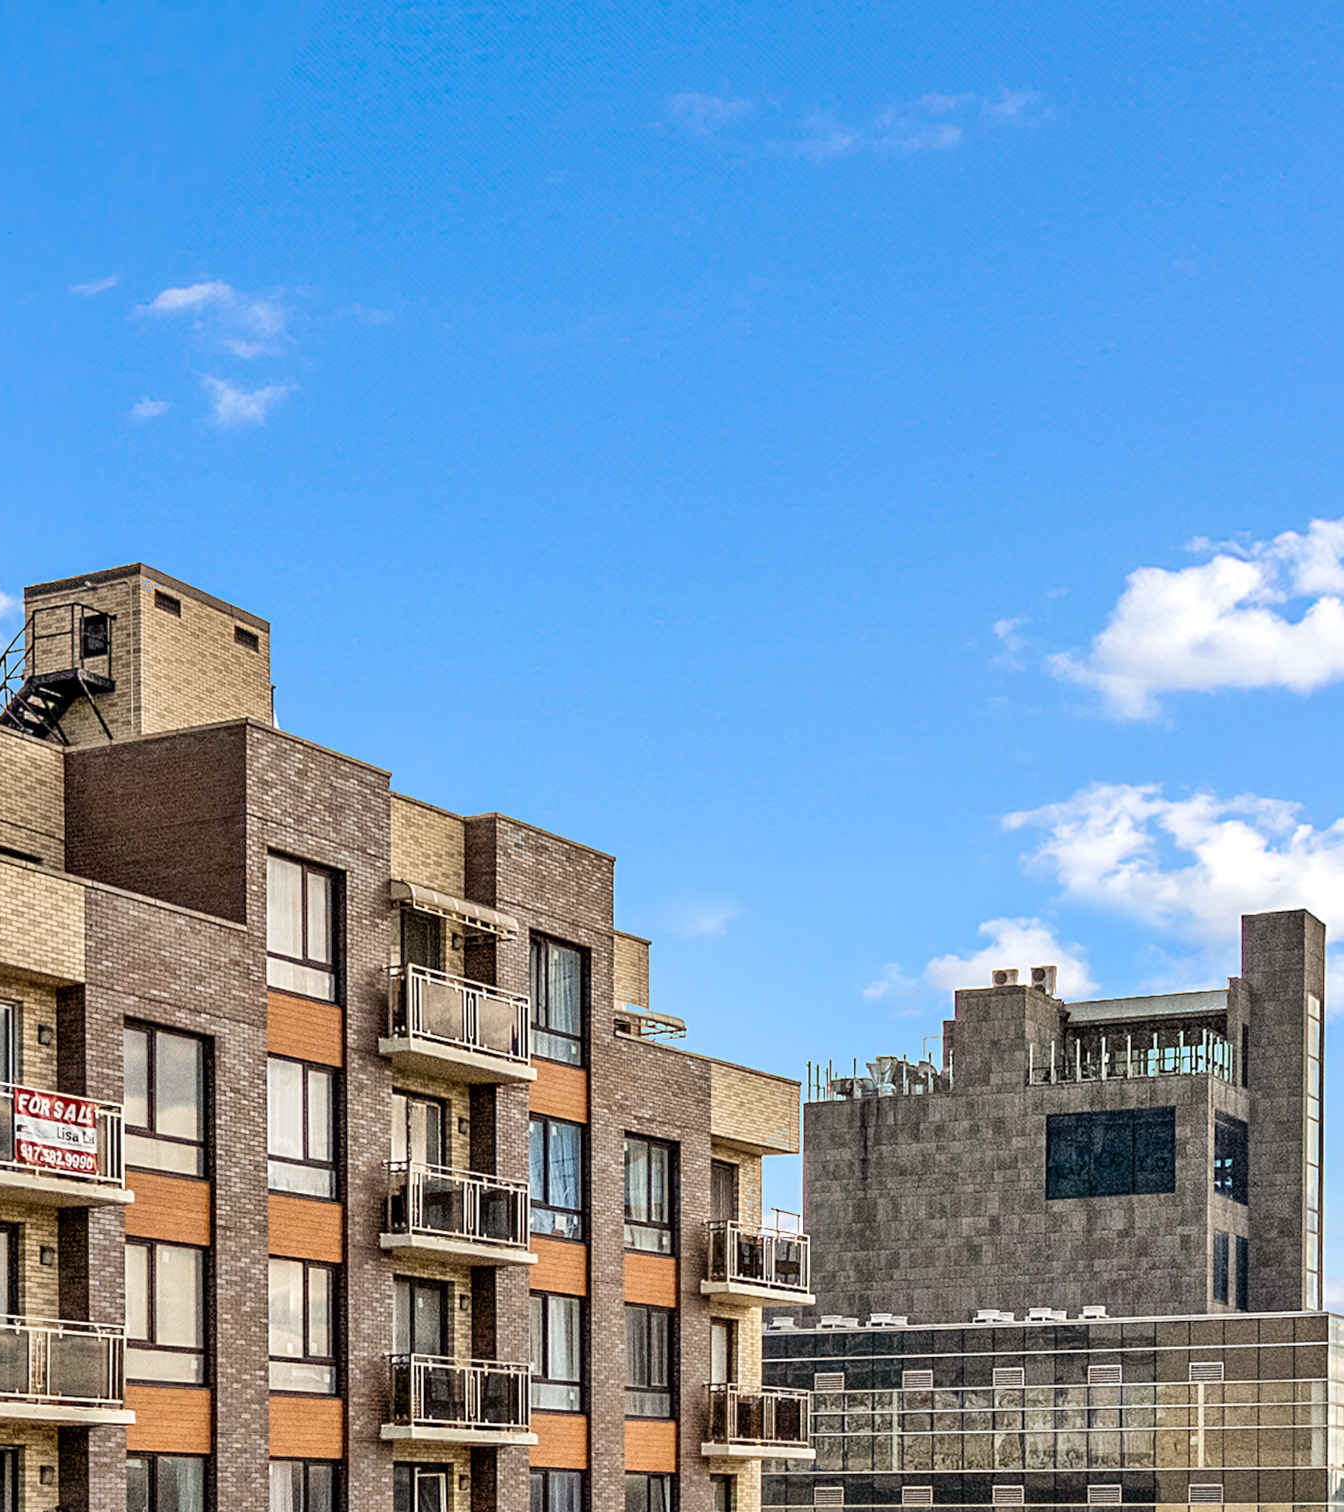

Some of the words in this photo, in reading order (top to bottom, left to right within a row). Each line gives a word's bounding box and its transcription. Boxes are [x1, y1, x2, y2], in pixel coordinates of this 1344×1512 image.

[18, 1093, 51, 1118] FOR
[53, 1102, 92, 1125] SALE
[56, 1124, 79, 1142] Lisa
